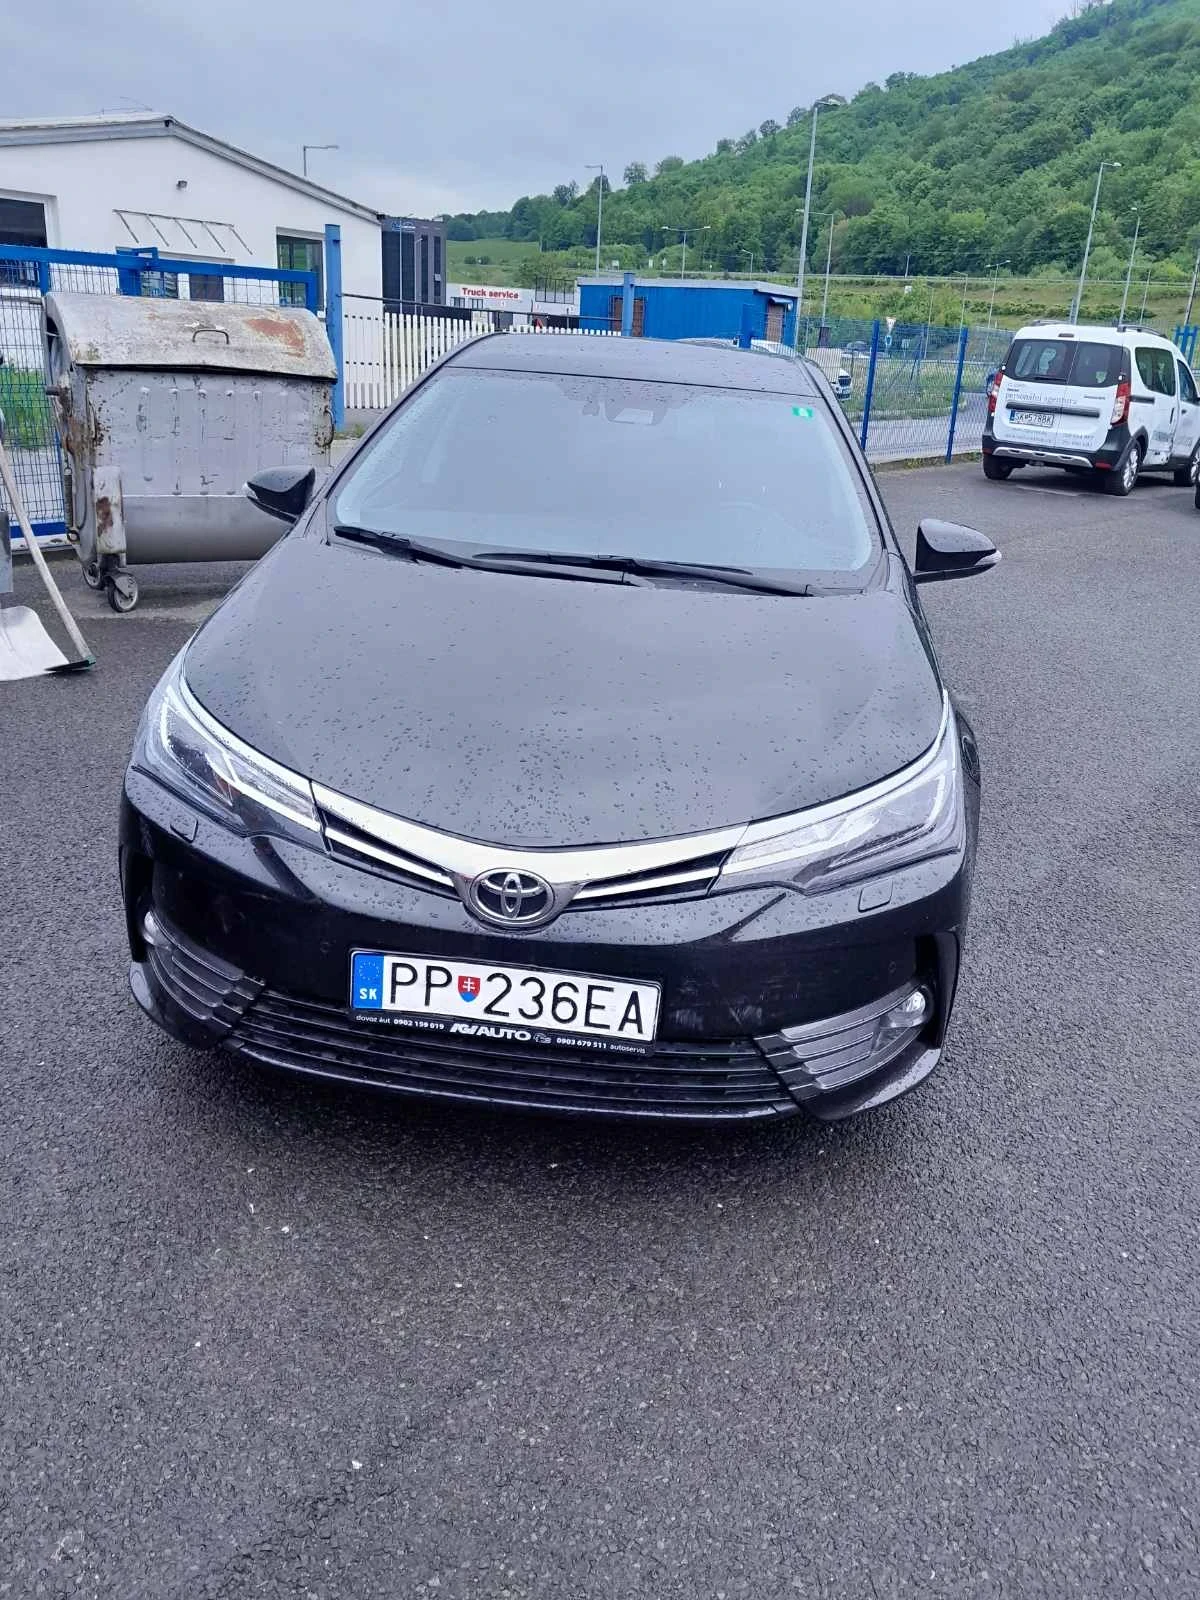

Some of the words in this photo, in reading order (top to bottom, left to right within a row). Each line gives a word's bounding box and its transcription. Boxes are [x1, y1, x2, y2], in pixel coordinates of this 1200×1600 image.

[462, 287, 486, 297] Truck
[489, 289, 519, 299] service
[359, 988, 377, 1000] SK
[390, 962, 453, 1007] PP
[483, 972, 644, 1035] 236EA
[556, 1037, 576, 1046] 0903
[609, 1044, 646, 1054] autoservis
